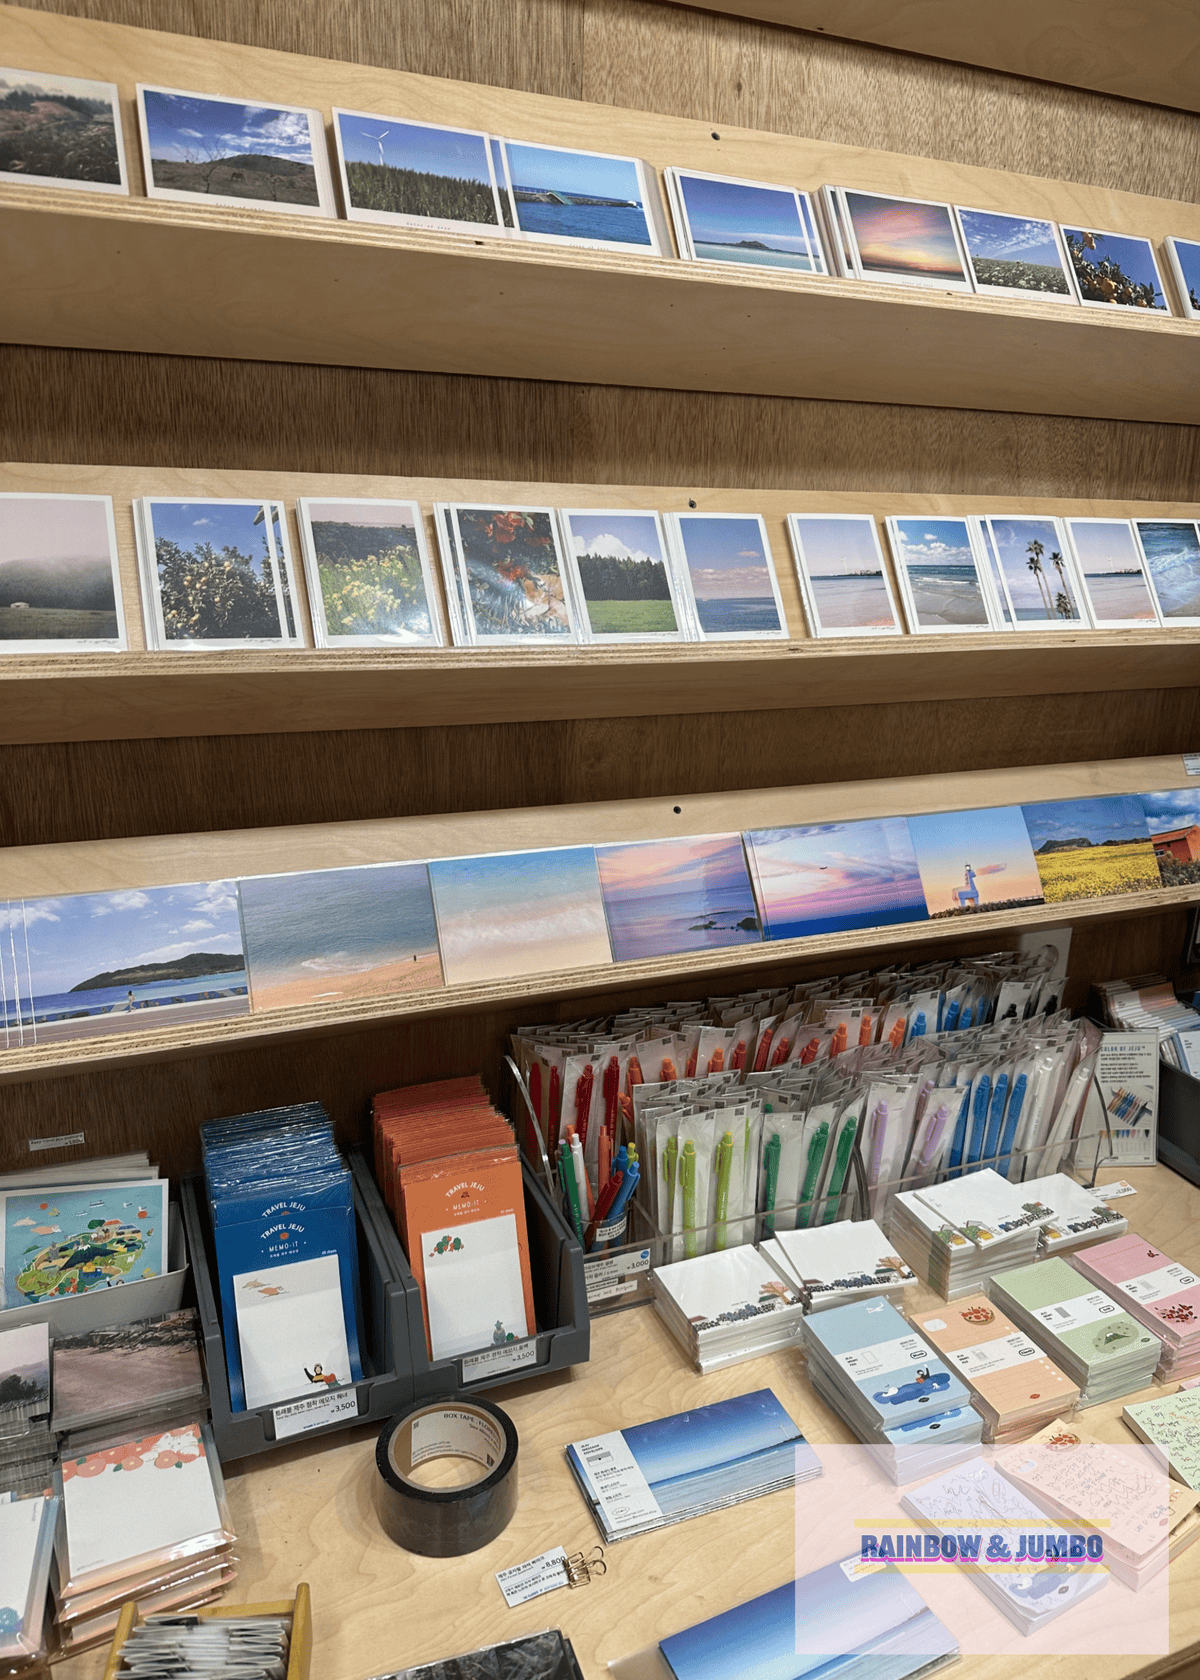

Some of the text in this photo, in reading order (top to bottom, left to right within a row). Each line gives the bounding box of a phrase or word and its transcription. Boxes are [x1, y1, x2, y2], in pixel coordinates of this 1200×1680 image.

[444, 1182, 485, 1198] TRAVEL JEJU
[262, 1202, 306, 1218] TRAVEL JEJU
[260, 1223, 305, 1240] TRAVEL JEJU
[268, 1240, 298, 1252] MEMO-IT
[459, 1412, 474, 1422] TAPE
